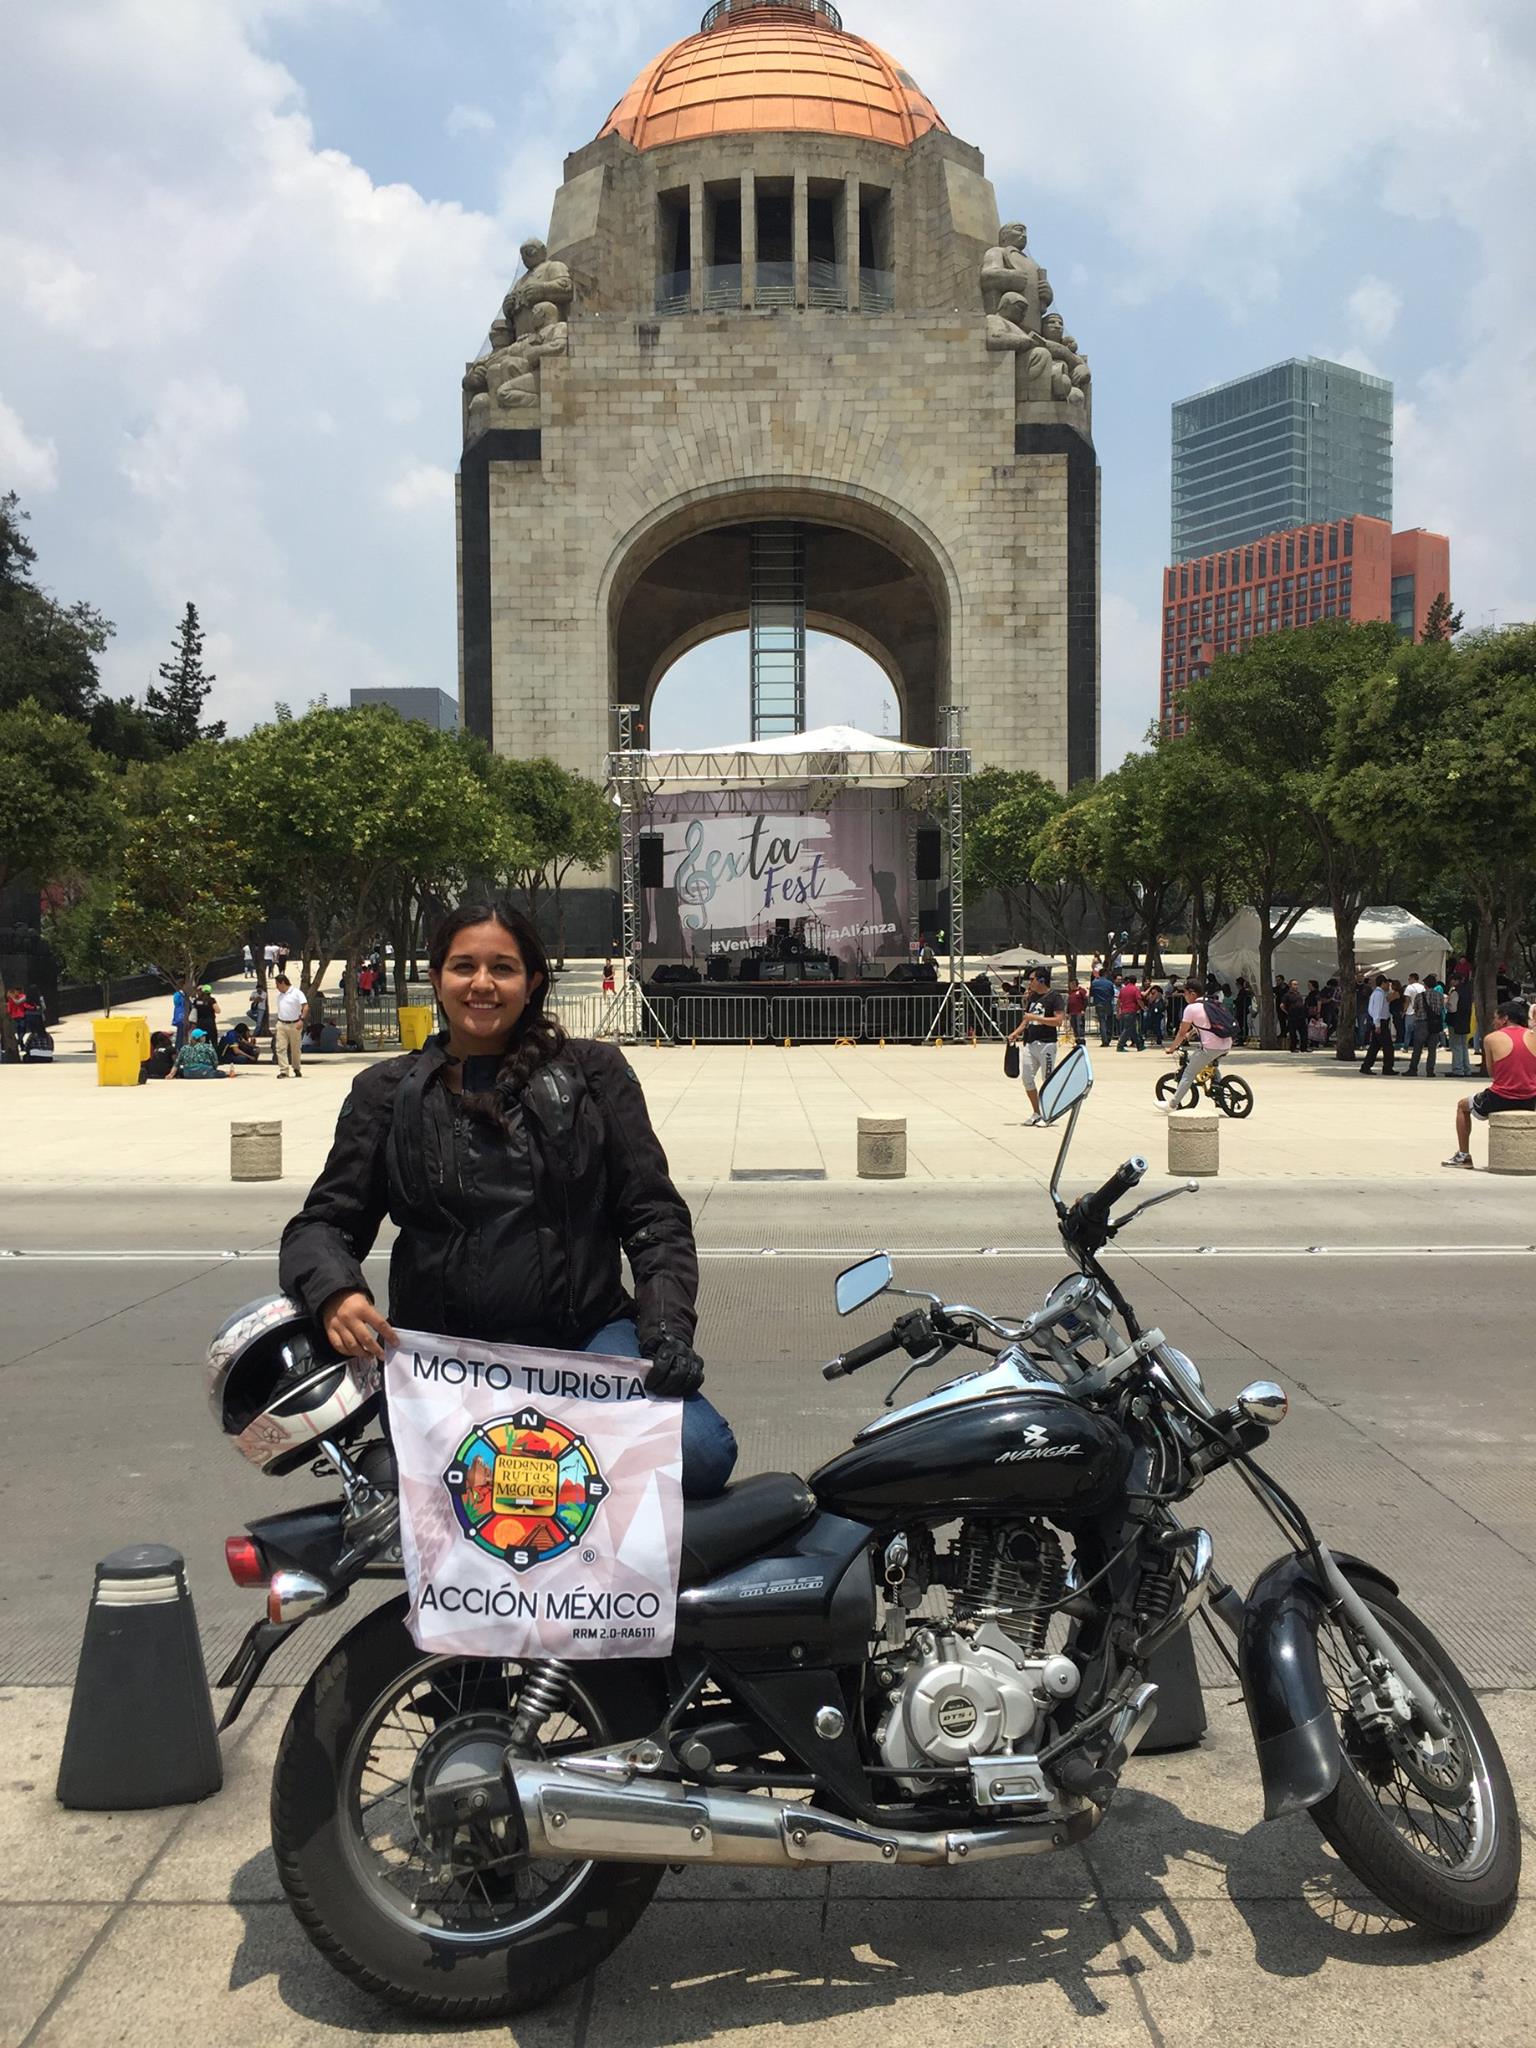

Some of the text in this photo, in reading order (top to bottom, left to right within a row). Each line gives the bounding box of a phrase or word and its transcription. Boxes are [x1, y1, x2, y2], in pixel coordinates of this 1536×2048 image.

[674, 814, 801, 930] Sexta
[764, 854, 826, 909] Fest
[413, 1352, 647, 1400] MOTO TURISTA
[521, 1413, 538, 1427] N
[994, 1444, 1085, 1464] AVENGER
[448, 1470, 463, 1484] O
[589, 1482, 603, 1495] E
[514, 1551, 529, 1565] S
[419, 1583, 660, 1620] ACCIÓN MÉXICO
[573, 1627, 655, 1639] RRM 2.0-RA6111
